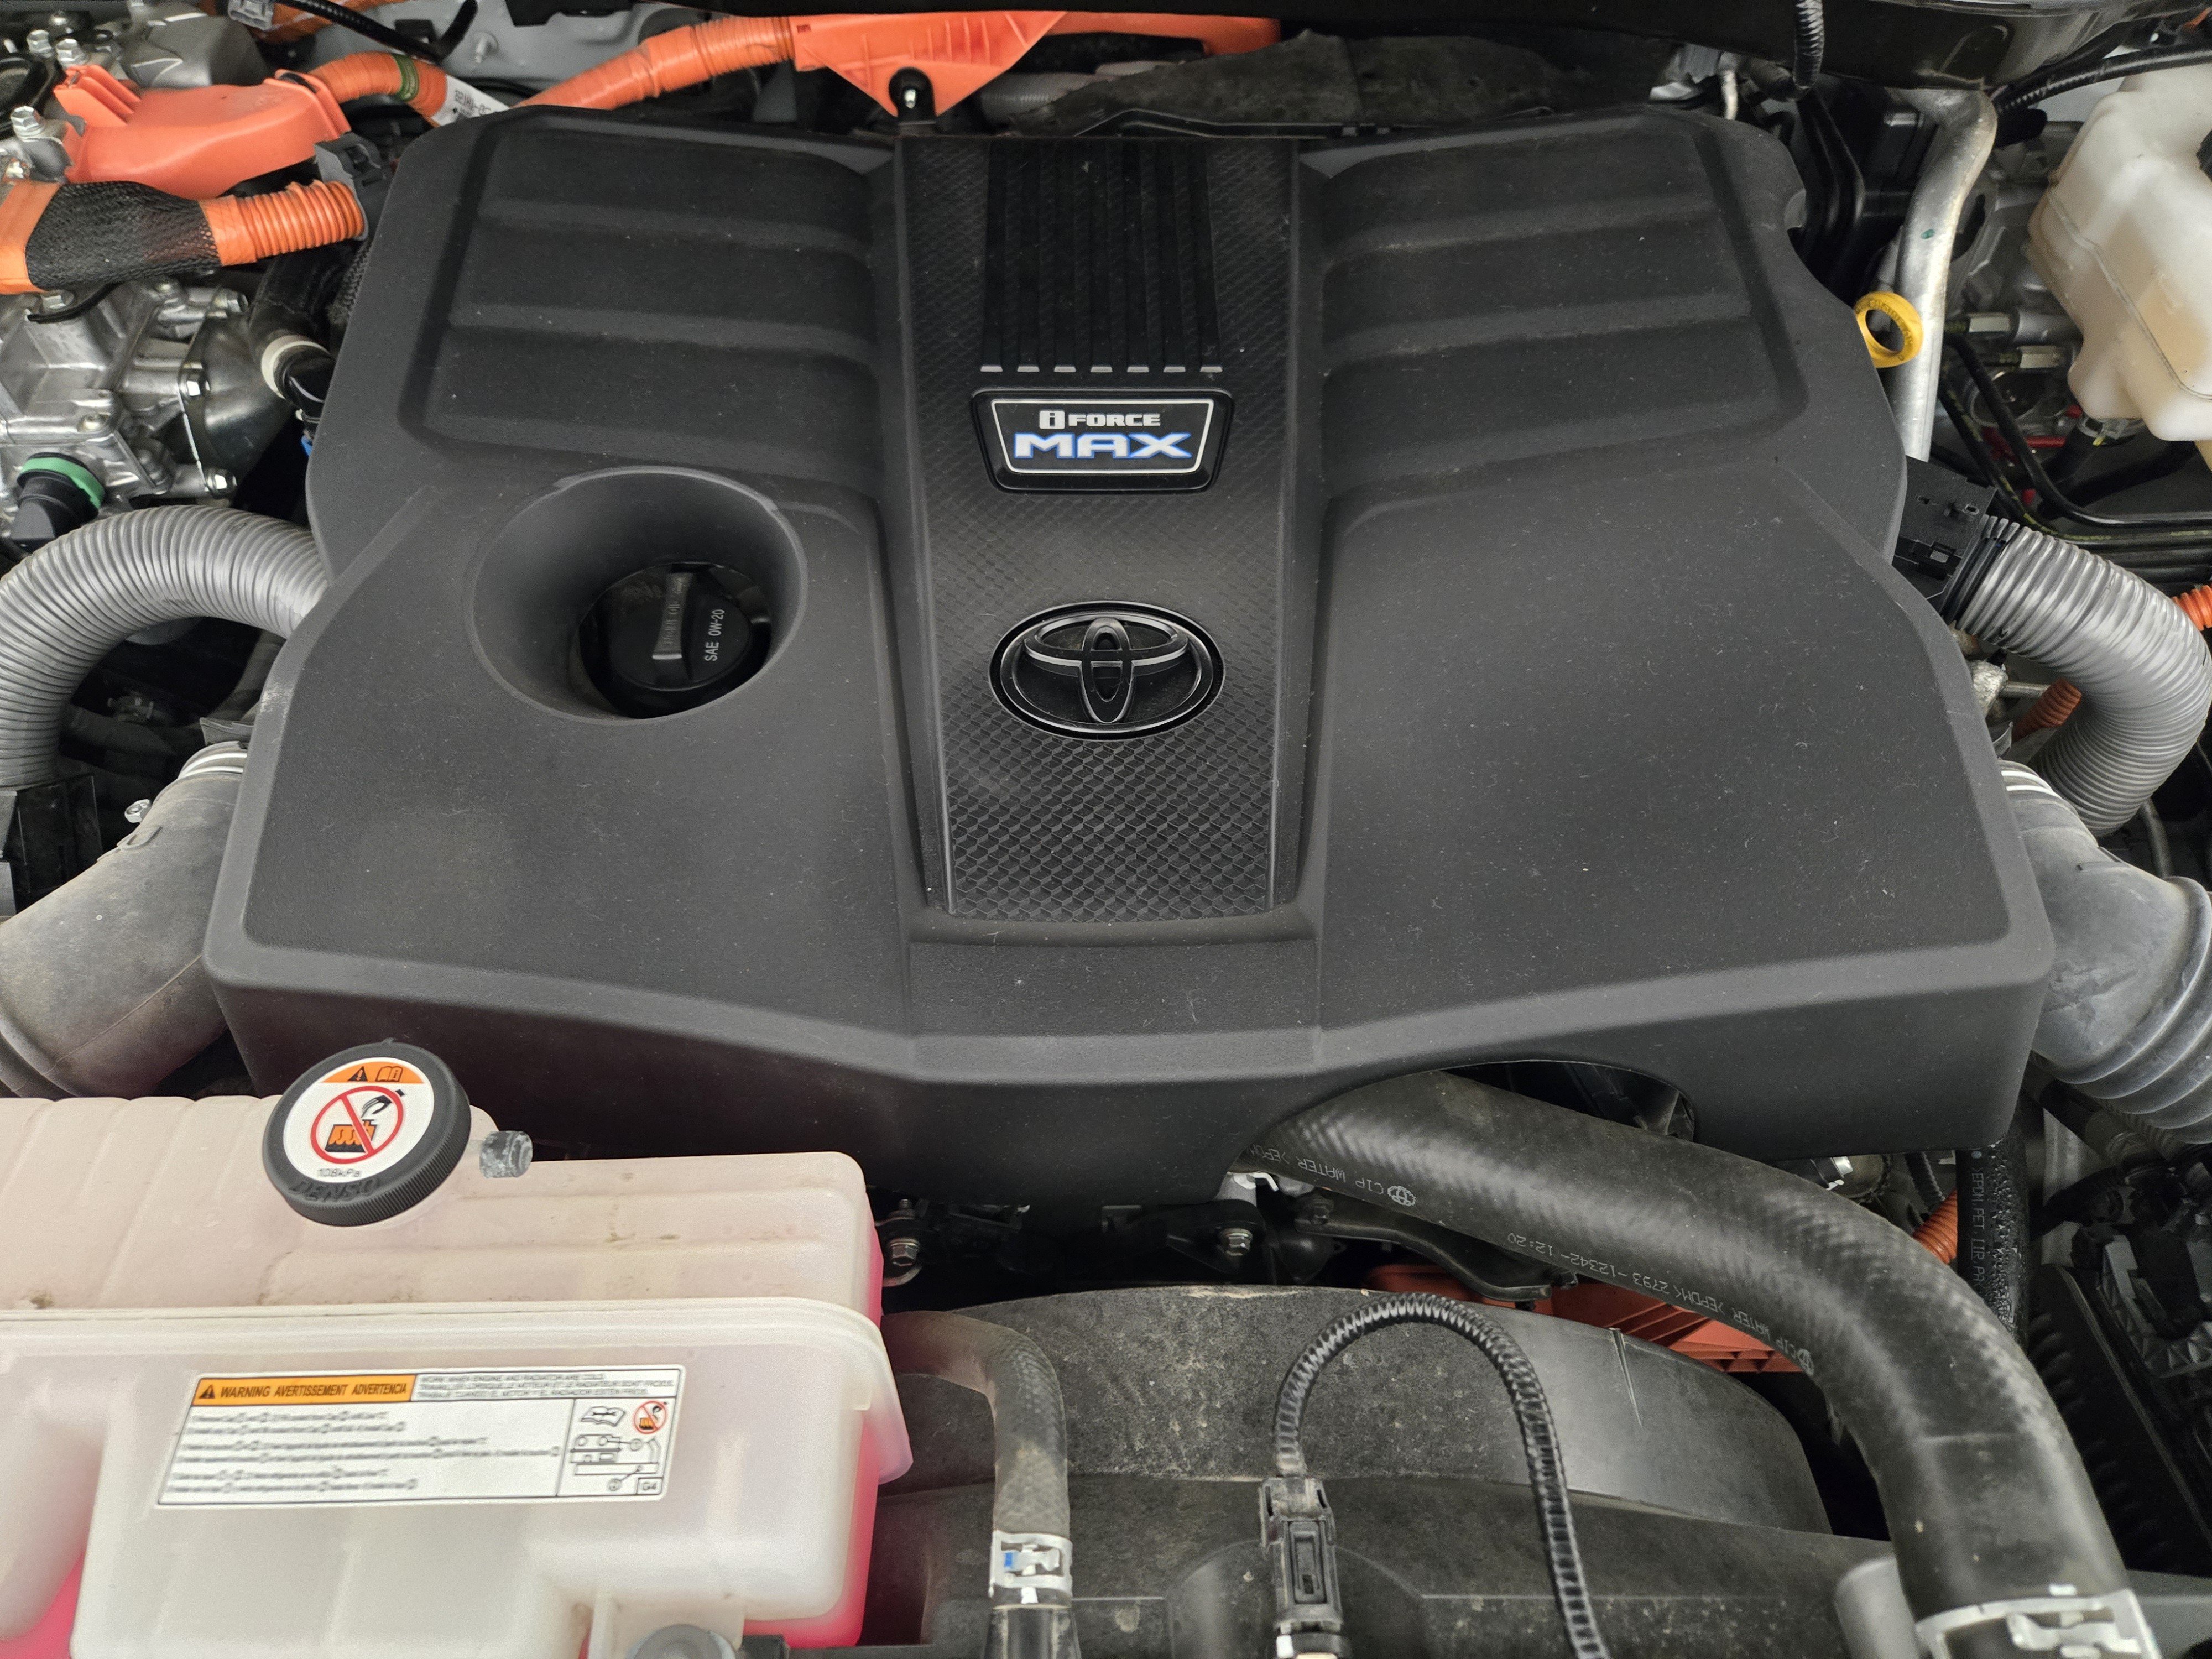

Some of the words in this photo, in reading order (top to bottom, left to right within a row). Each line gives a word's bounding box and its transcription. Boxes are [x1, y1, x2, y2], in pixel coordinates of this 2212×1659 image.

[1068, 414, 1161, 426] FORCE
[1013, 432, 1192, 459] MAX
[708, 609, 725, 637] 0W-20
[705, 641, 719, 661] SAE
[318, 1168, 362, 1177] 108kPa
[1296, 1156, 1346, 1183] WATER
[289, 1179, 377, 1202] DENSO
[1507, 1233, 1553, 1256] 12:20
[1632, 1272, 1670, 1295] 2793
[220, 1385, 272, 1398] WARNING
[274, 1384, 348, 1397] AVERTISSEMENT
[351, 1383, 407, 1395] ADVERTENCIA
